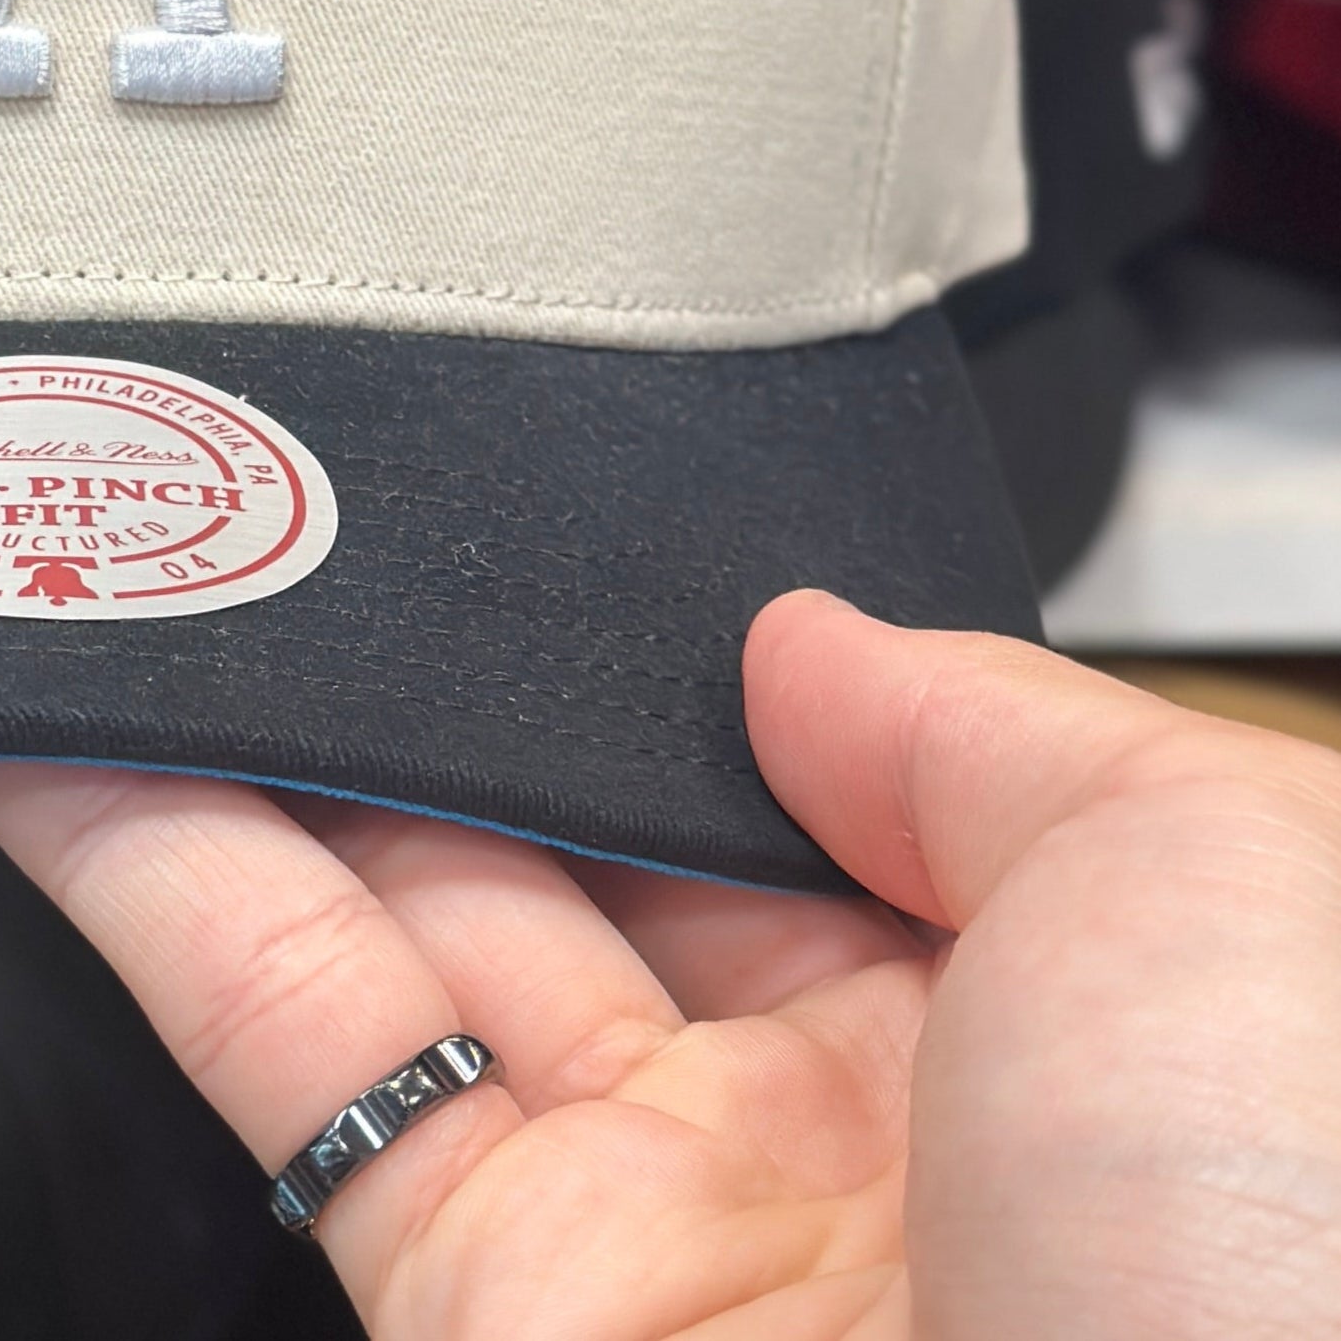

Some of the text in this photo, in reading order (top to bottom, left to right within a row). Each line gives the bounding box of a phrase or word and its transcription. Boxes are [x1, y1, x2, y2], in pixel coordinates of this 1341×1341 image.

[39, 375, 253, 456] PHILADELPHIA,
[244, 464, 279, 485] PA
[69, 442, 97, 456] &
[103, 441, 199, 463] Ness
[27, 477, 247, 512] PINCH
[0, 504, 107, 527] FIT
[160, 553, 218, 580] 04
